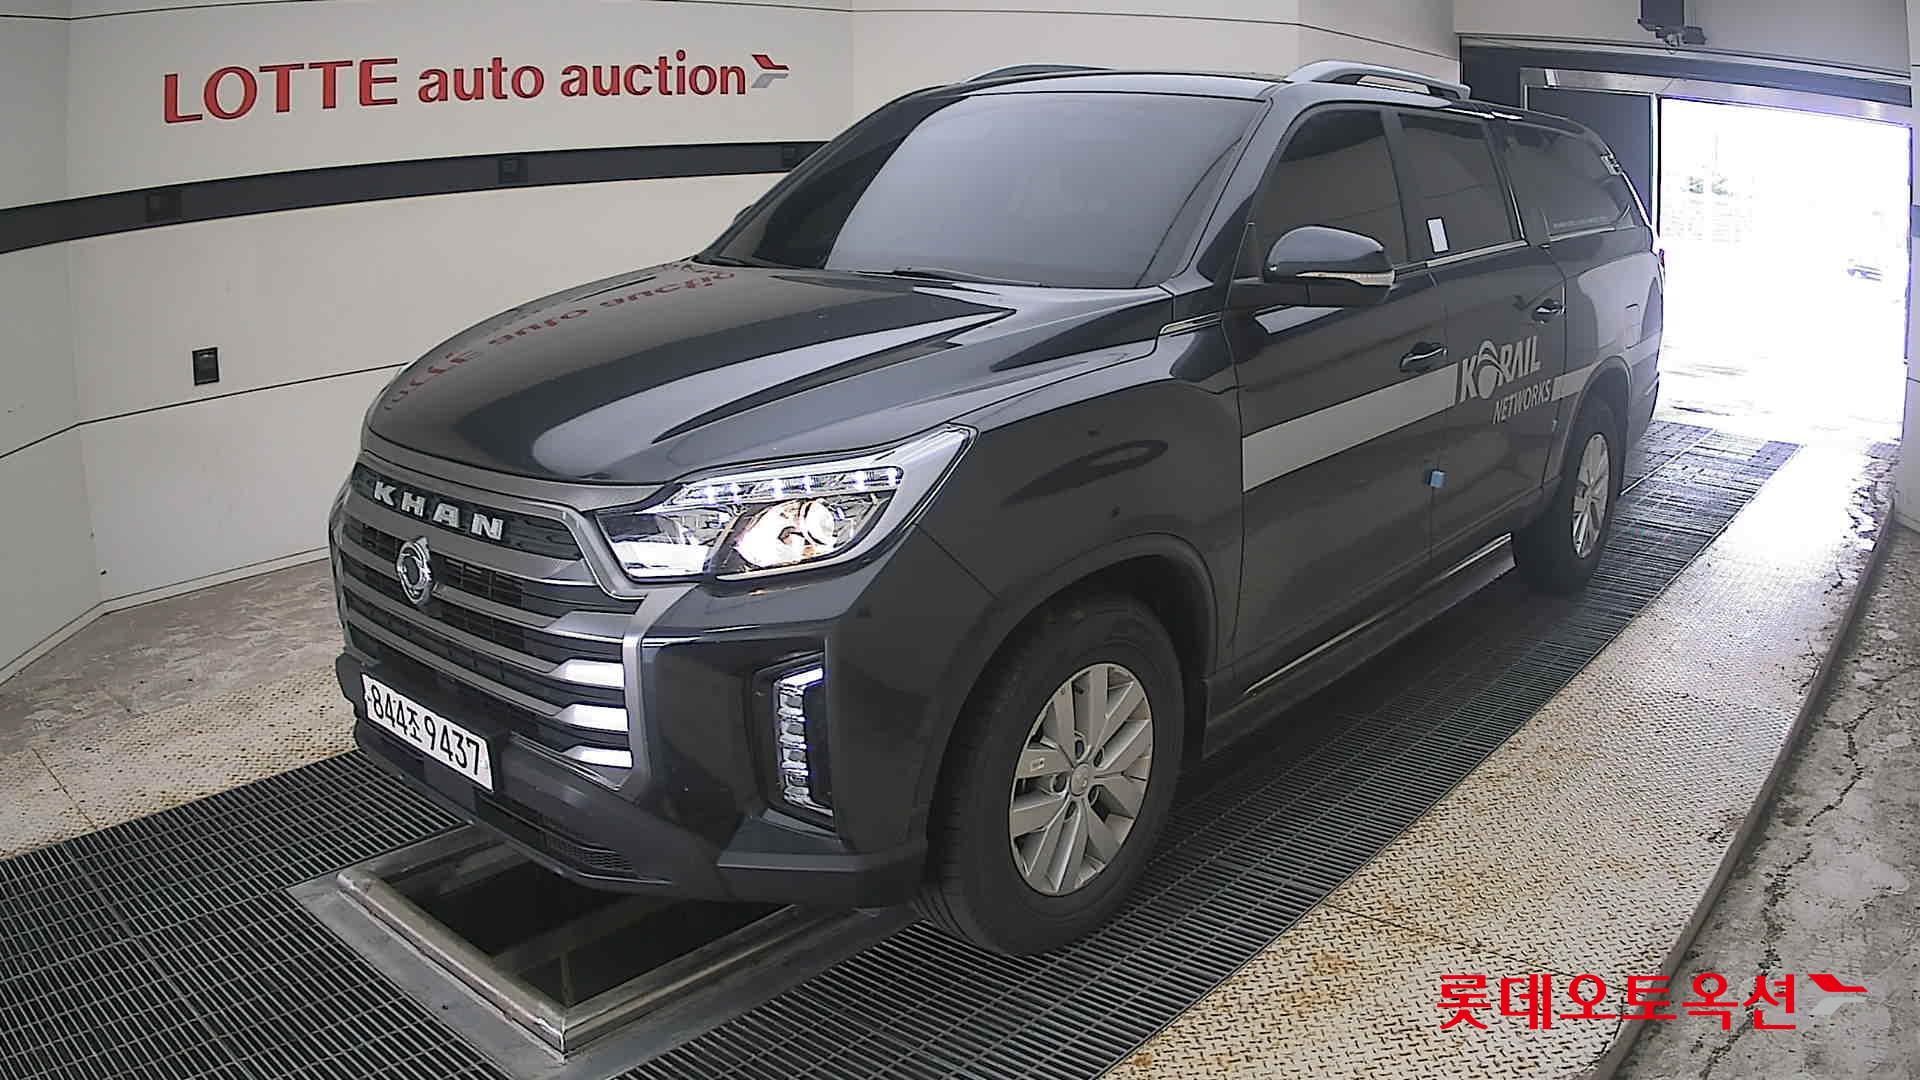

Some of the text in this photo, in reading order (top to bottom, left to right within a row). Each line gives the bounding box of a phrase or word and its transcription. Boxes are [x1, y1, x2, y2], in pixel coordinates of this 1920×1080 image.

[164, 49, 747, 124] LOTTE auto auction
[1460, 335, 1541, 403] KORAIL
[1493, 379, 1551, 425] NETWORKS
[373, 480, 504, 541] KHAN
